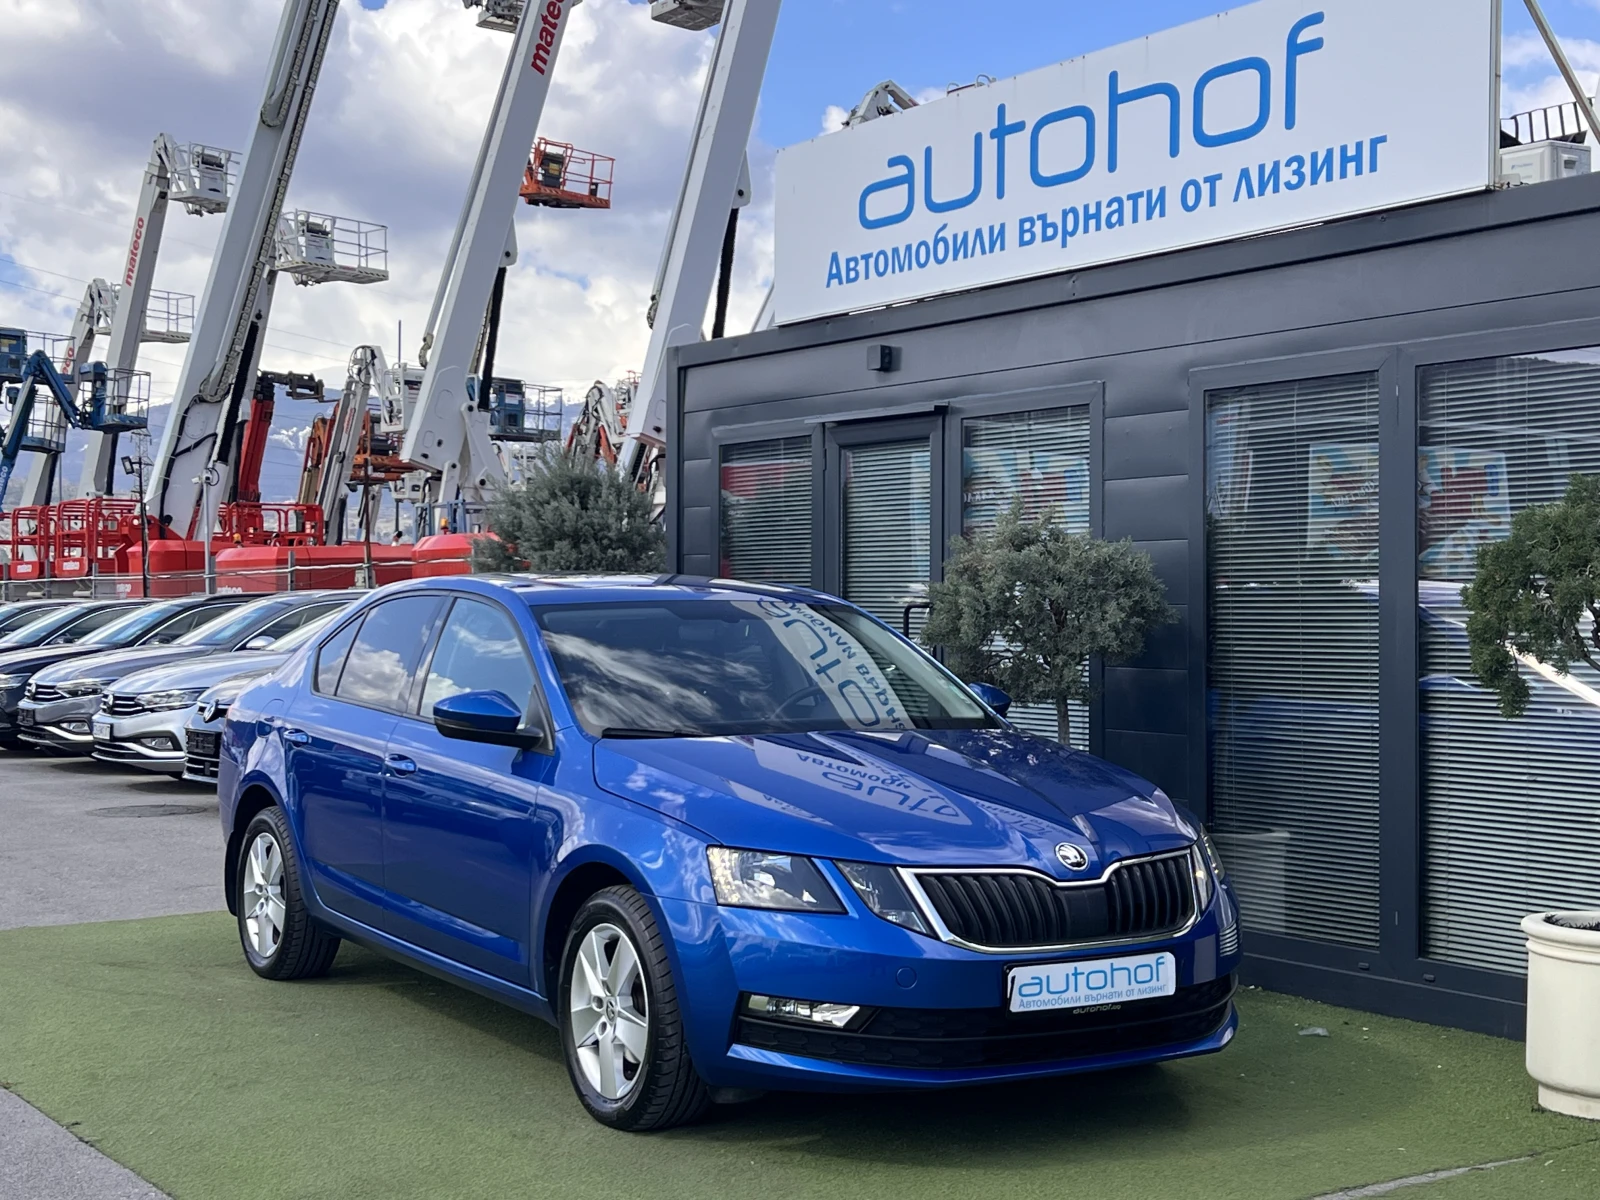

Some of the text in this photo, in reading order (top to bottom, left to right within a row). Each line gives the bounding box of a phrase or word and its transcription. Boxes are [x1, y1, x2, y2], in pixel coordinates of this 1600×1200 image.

[531, 0, 565, 75] mate
[859, 11, 1325, 230] autohof
[826, 134, 1388, 288] Автомобили върнати от лизинг
[125, 217, 144, 287] mateco
[1018, 956, 1165, 997] autohof
[1018, 984, 1167, 1010] Автомобили върнати от лизинг
